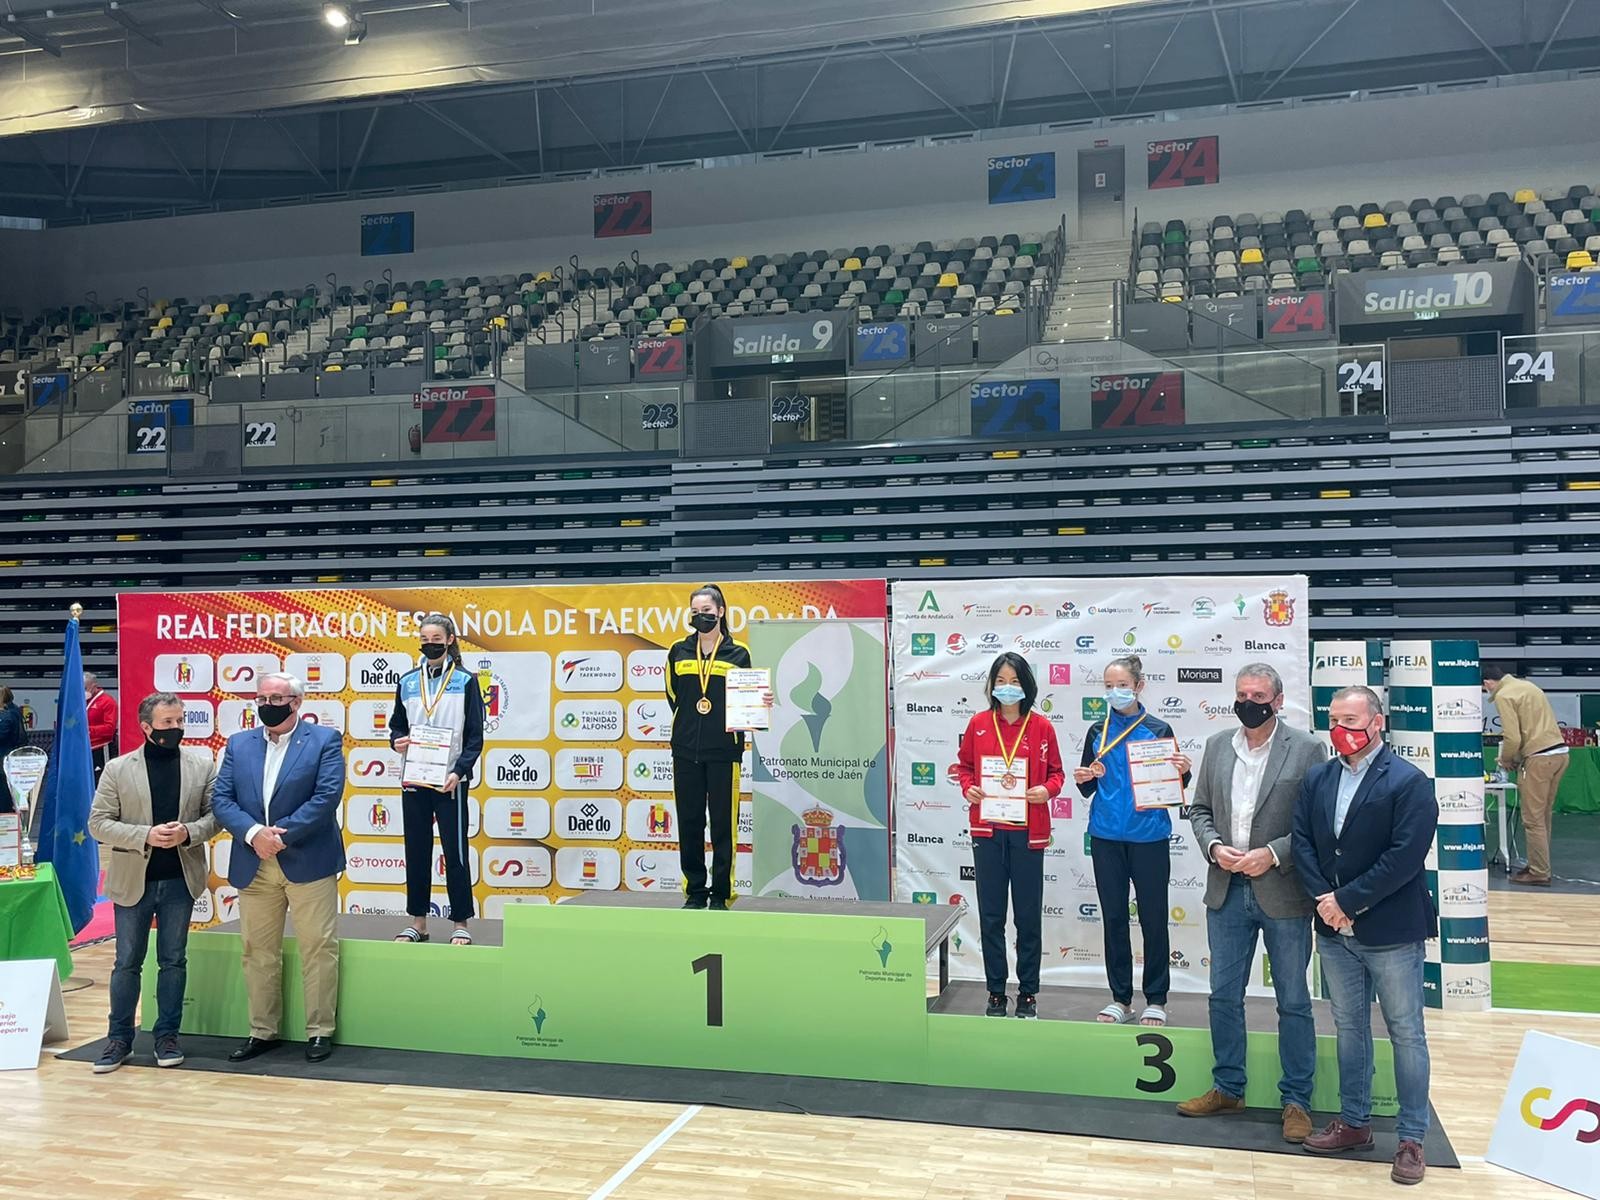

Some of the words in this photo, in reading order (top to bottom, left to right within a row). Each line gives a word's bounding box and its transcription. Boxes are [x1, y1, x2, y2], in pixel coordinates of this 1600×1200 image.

[1147, 140, 1192, 155] Sector
[988, 157, 1031, 171] Sector
[1149, 136, 1218, 190] 24
[594, 195, 629, 207] Sector
[361, 215, 395, 226] Sector
[595, 192, 651, 237] 22
[1551, 276, 1591, 287] Sector
[1365, 288, 1450, 312] Salida
[1453, 272, 1492, 306] 10
[1267, 295, 1303, 305] Sector
[1268, 292, 1325, 333] 24
[857, 326, 888, 336] Sector
[733, 334, 800, 355] Salida
[813, 320, 833, 350] 9
[638, 340, 666, 349] Sector
[640, 338, 684, 374] 22
[1508, 351, 1554, 384] 24
[32, 376, 56, 384] Sector
[1338, 360, 1382, 393] 24
[1091, 376, 1149, 392] Sector
[422, 388, 468, 400] Sector
[971, 384, 1027, 399] Sector
[1092, 372, 1185, 429] 24
[128, 403, 170, 414] Sector
[772, 395, 811, 424] 23
[422, 387, 495, 443] 22
[642, 403, 679, 429] 23
[772, 413, 800, 422] Sector
[642, 420, 668, 430] Sector
[137, 427, 166, 452] 22
[246, 422, 276, 447] 22
[157, 614, 219, 640] REAL
[226, 605, 387, 639] FEDERACIÓN
[396, 604, 536, 637] ESAÑOLA
[545, 608, 577, 635] DE
[1019, 636, 1061, 649] sotelecc
[1245, 640, 1285, 650] Blanca
[1328, 655, 1363, 667] IFEJA
[1395, 655, 1427, 667] IFEJA
[648, 666, 665, 676] TOY
[1180, 669, 1219, 680] Moriana
[907, 703, 942, 713] Blanca
[1398, 746, 1430, 757] IFEJA
[760, 756, 808, 767] Patronato
[811, 757, 860, 768] Municipal
[863, 758, 876, 768] de
[773, 769, 819, 780] Deportes
[822, 769, 835, 779] de
[839, 769, 863, 780] Jaén
[908, 834, 944, 845] Blanca
[365, 857, 406, 868] TOYOTA
[1043, 905, 1063, 915] lecc
[691, 953, 723, 1027] 1
[0, 1019, 17, 1027] erior
[0, 1026, 28, 1034] eportes
[1135, 1033, 1176, 1093] 3
